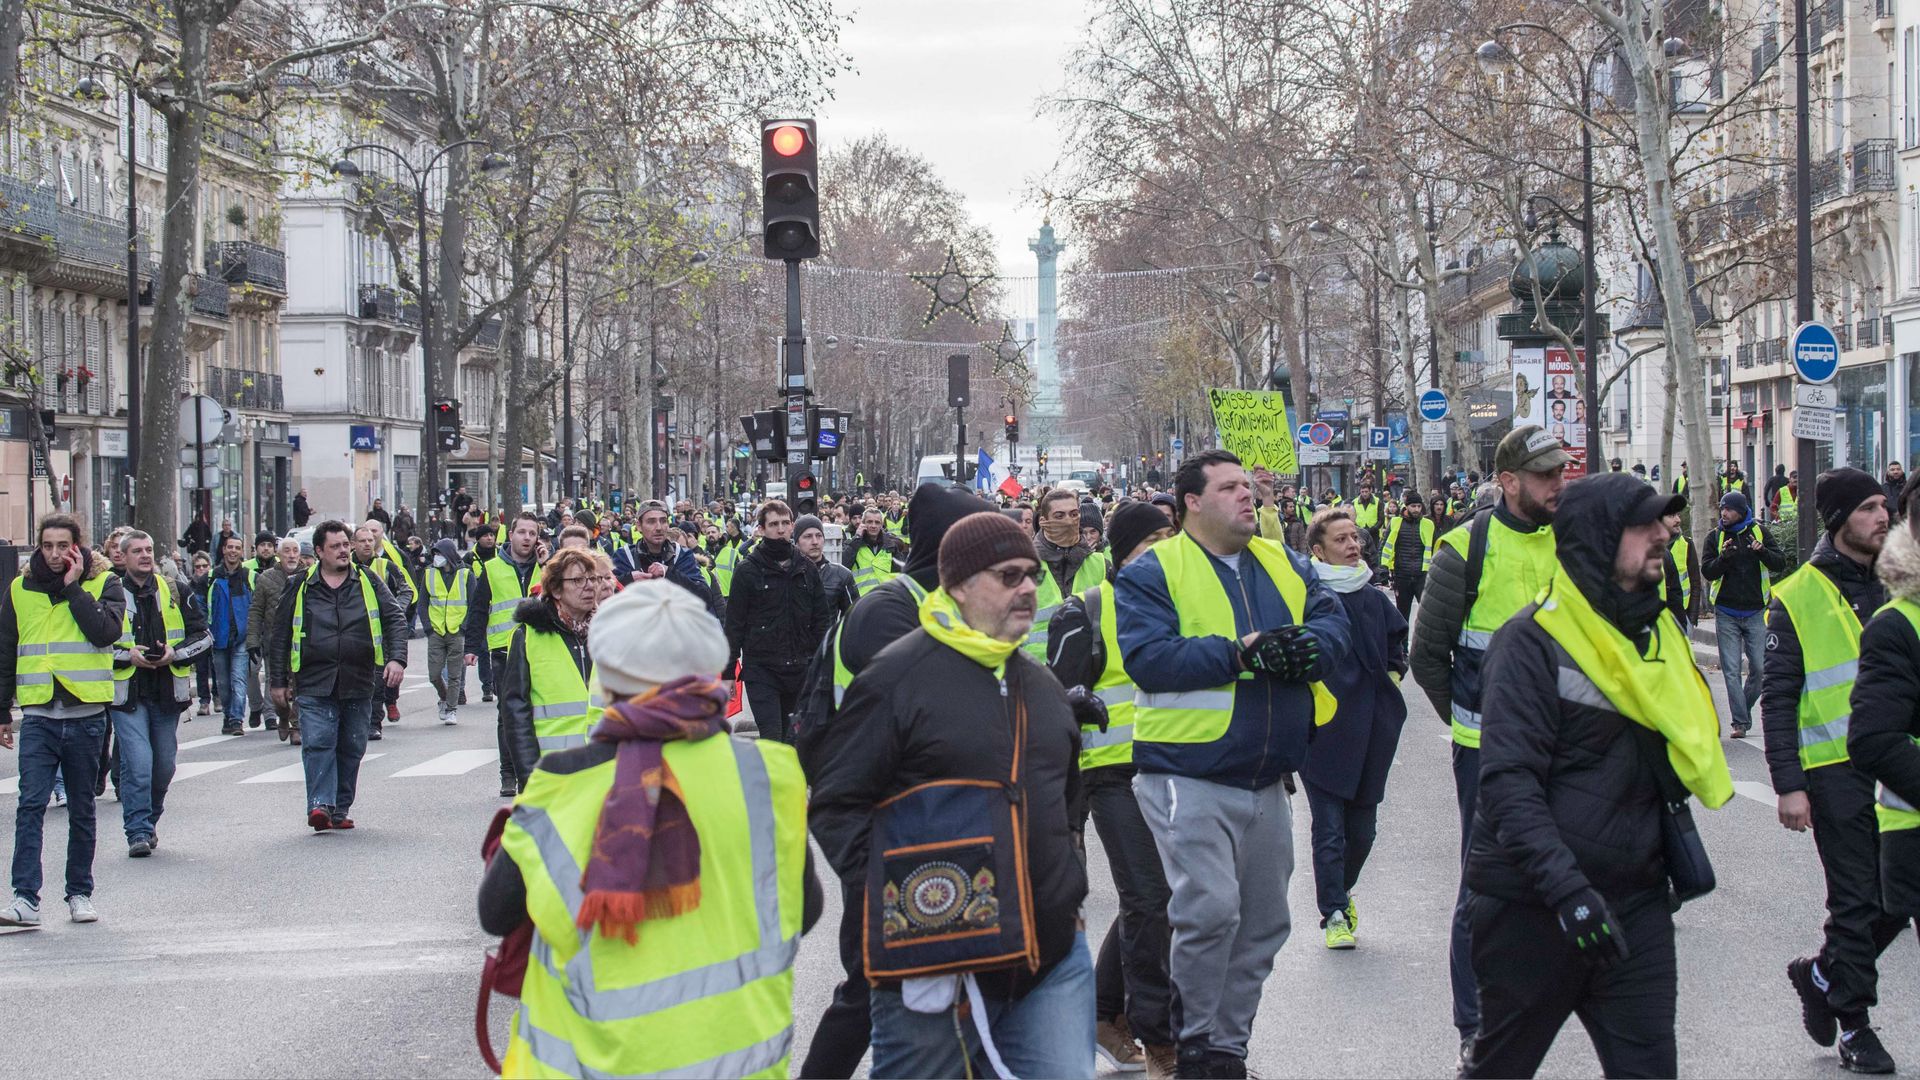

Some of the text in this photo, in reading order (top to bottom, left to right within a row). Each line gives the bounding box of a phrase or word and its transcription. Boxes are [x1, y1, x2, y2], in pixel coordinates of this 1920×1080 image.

[1263, 394, 1276, 410] et
[353, 437, 371, 446] AXA
[1375, 432, 1384, 444] P
